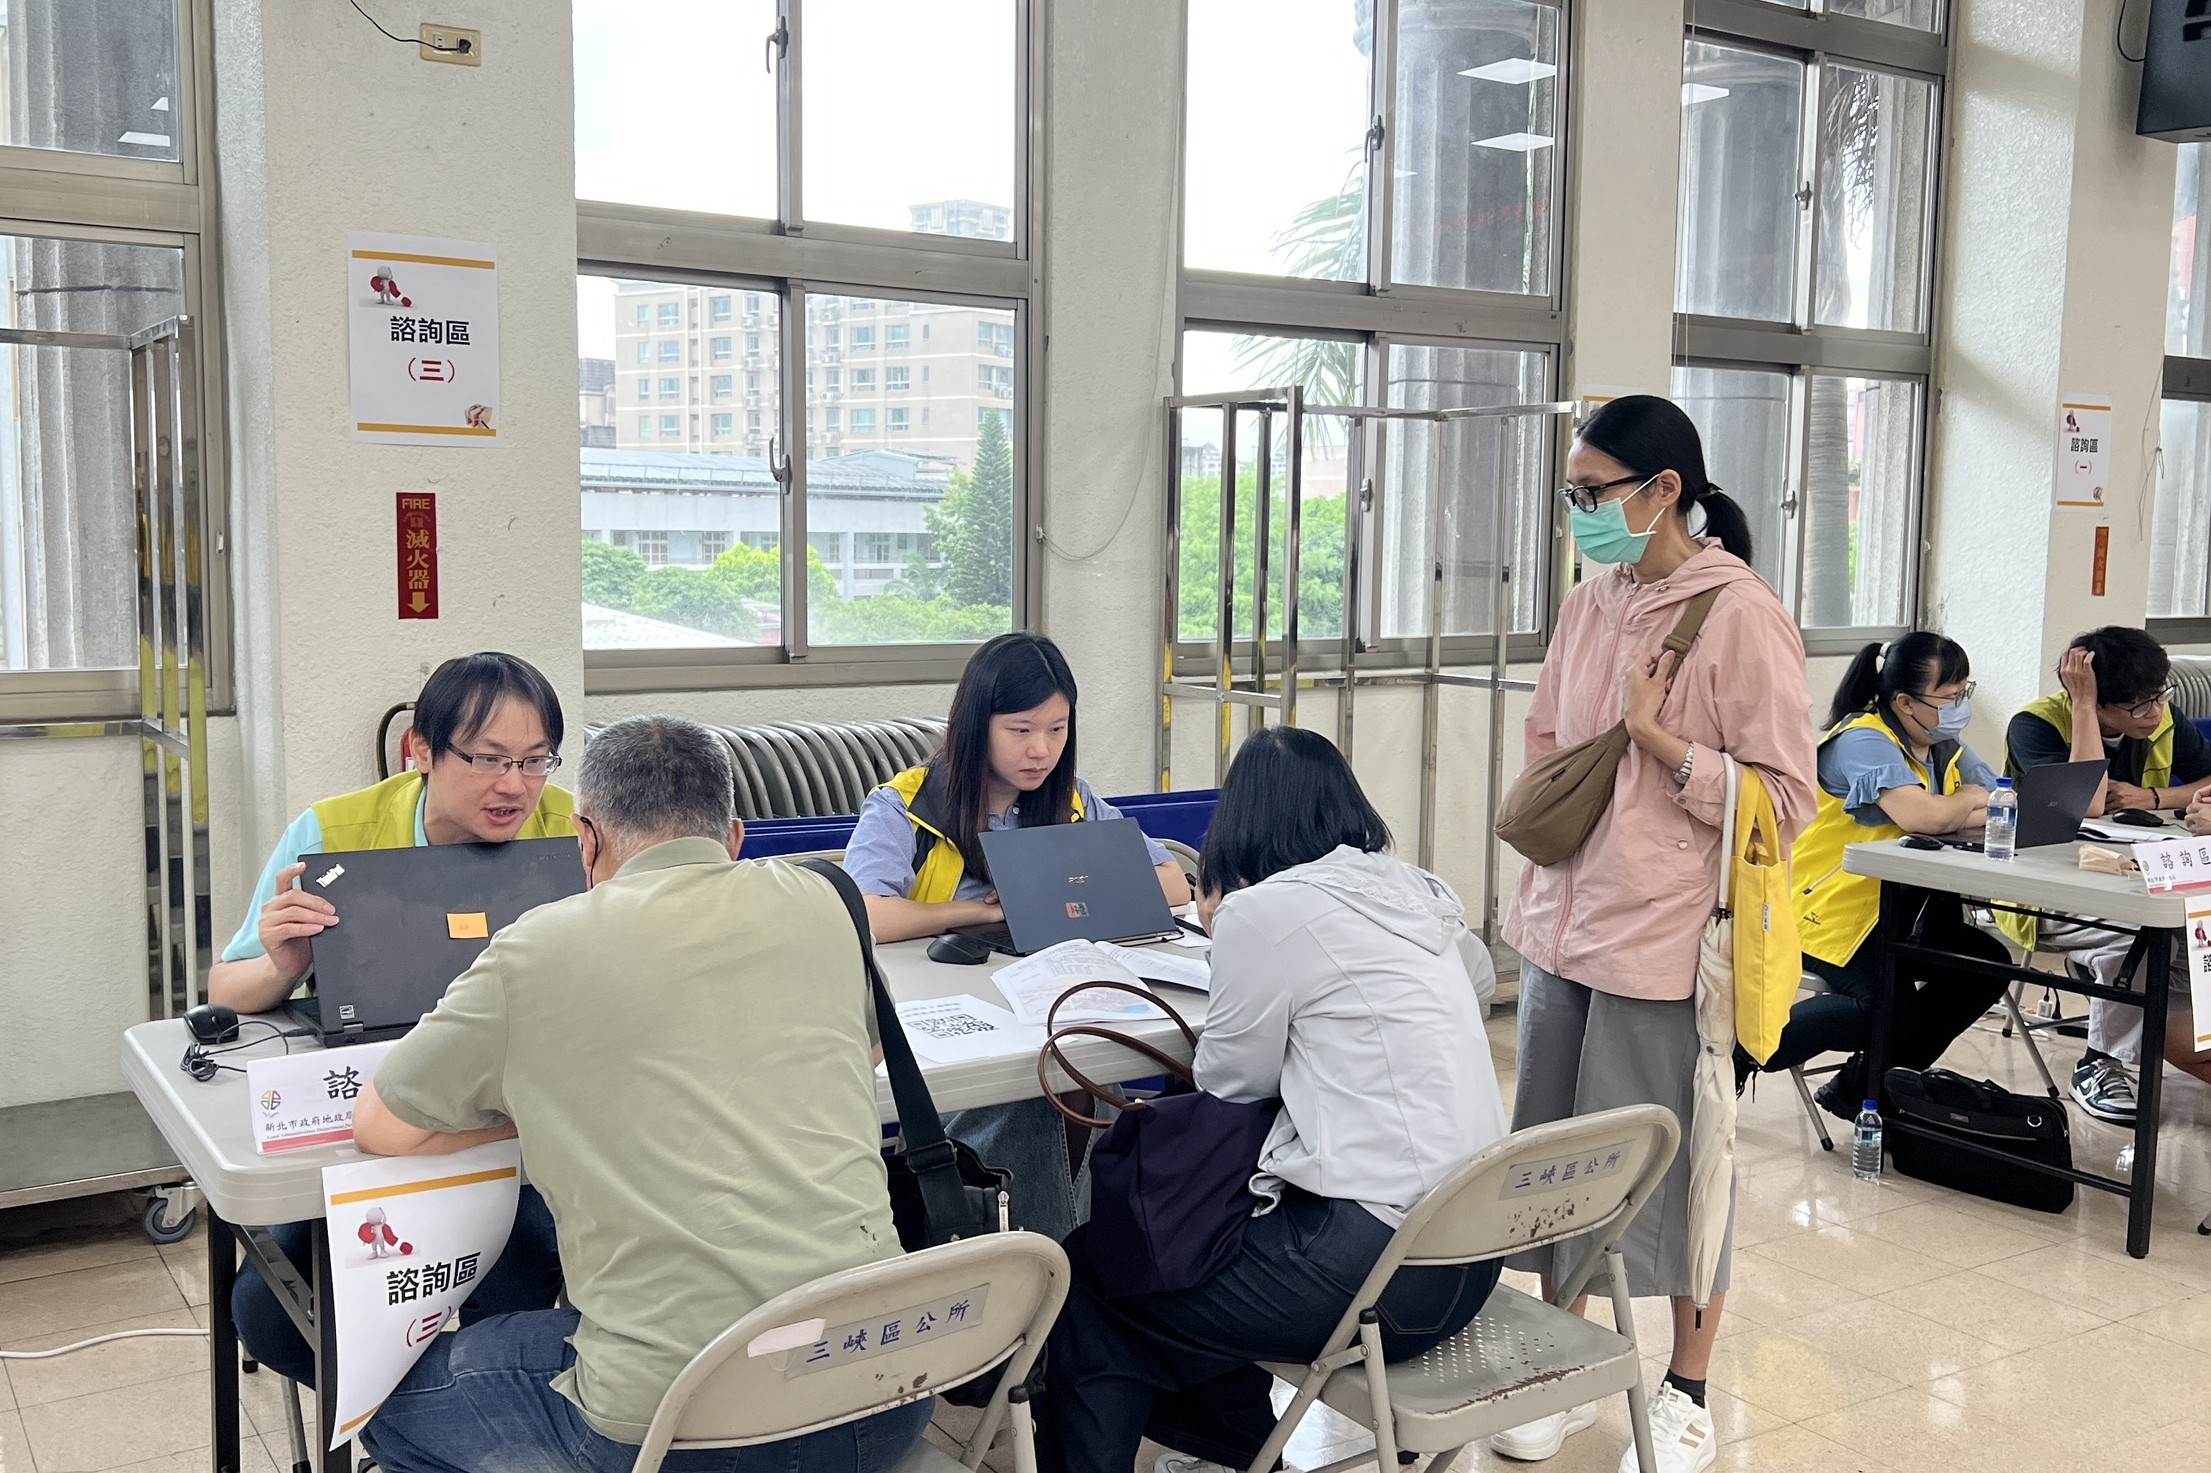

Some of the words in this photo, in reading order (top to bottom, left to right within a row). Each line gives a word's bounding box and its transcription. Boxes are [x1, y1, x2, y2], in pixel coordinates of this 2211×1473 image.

[390, 316, 470, 345] 諮詢區
[408, 357, 455, 383] （三）
[2071, 437, 2098, 453] 諮詢區
[402, 498, 431, 509] FIRE
[405, 529, 430, 589] 滅火器
[2160, 847, 2211, 870] 諮詢區
[323, 1066, 363, 1100] 諮
[1514, 1151, 1621, 1189] 三峽區公所
[387, 1251, 481, 1306] 諮詢區
[806, 1299, 970, 1363] 三峽區公所
